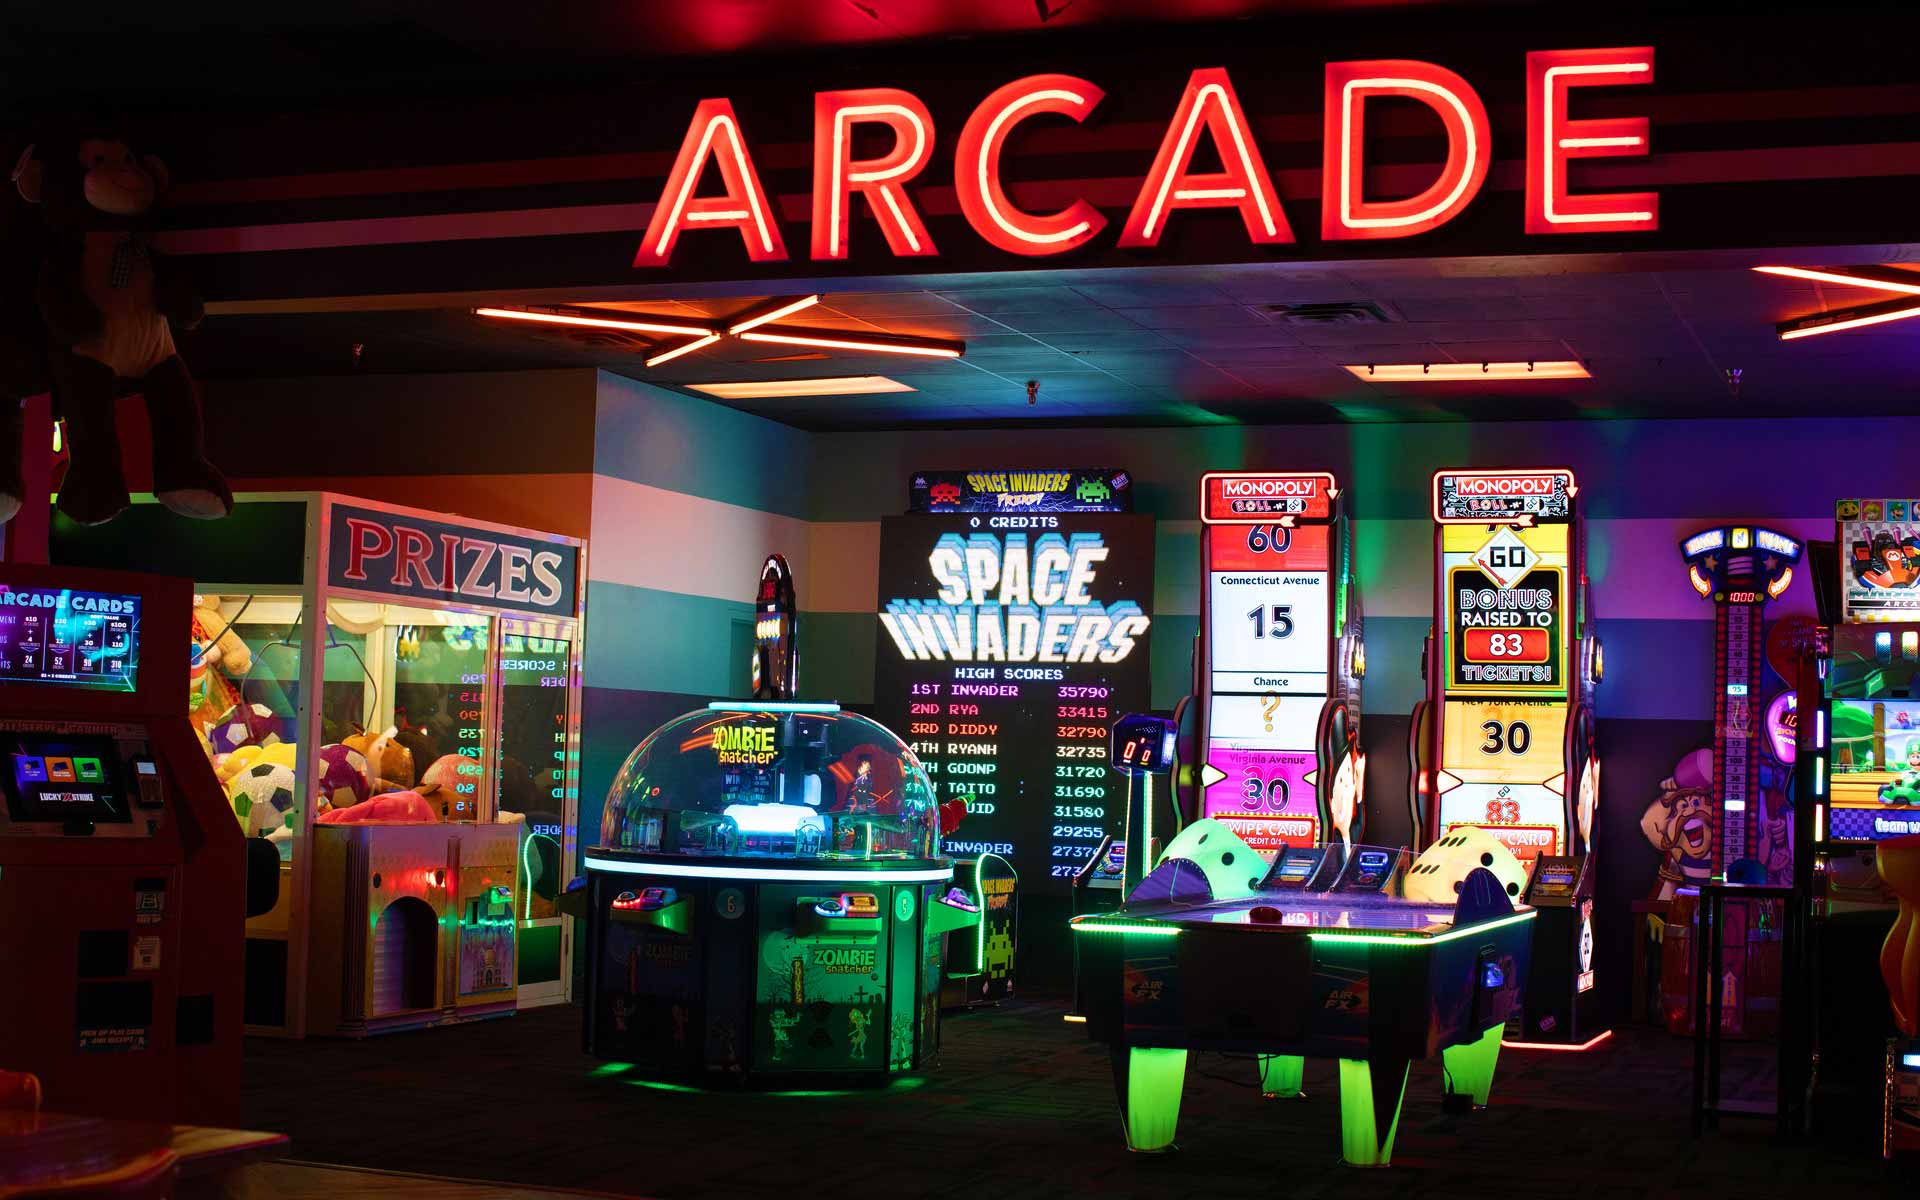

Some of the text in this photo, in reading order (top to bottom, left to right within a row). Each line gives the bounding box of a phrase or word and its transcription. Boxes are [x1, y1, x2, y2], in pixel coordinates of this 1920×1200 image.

[632, 46, 1659, 268] ARCADE
[967, 473, 1072, 492] SPACE INVADERS
[1226, 480, 1313, 495] MONOPOLY
[1460, 479, 1551, 494] MONOPOLY
[1235, 500, 1272, 511] ROLL
[1470, 500, 1508, 510] ROLL
[970, 517, 1058, 528] 0 CREDITS
[1247, 524, 1292, 554] 60
[344, 518, 562, 606] PRIZES
[1490, 546, 1525, 568] GO
[929, 534, 1109, 606] SPACE
[1220, 576, 1319, 585] Connecticut Avenue
[1460, 588, 1552, 610] BONUS
[1730, 592, 1754, 602] 1000
[72, 597, 134, 613] CARDS
[1247, 604, 1295, 639] 15
[1461, 612, 1552, 626] RAISED TO
[878, 602, 1150, 663] INVADERS
[1490, 633, 1523, 656] 83
[955, 668, 1063, 680] HIGH SCORES
[1462, 665, 1552, 681] TICKETS!
[1253, 677, 1289, 686] Chance
[911, 684, 1108, 698] 1ST INVADER 35790
[911, 703, 1108, 718] 2ND RYA 33415
[911, 723, 1107, 738] 3RD DIDDY 32790
[1480, 720, 1532, 755] 30
[719, 750, 774, 765] snatcher
[910, 742, 1106, 758] 4TH RYANH 32735
[1229, 754, 1306, 765] Virginia Avenue
[948, 763, 996, 775] GOONP
[1055, 766, 1105, 778] 31720
[39, 792, 62, 801] LUCKY
[948, 783, 996, 795] TAITO
[1054, 786, 1105, 798] 31690
[1241, 772, 1290, 812] 30
[1054, 806, 1104, 818] 31580
[1486, 800, 1520, 823] 83
[1053, 826, 1103, 838] 29255
[1268, 822, 1309, 836] CARD
[1244, 837, 1269, 845] CREDIT
[1507, 831, 1550, 846] CARD
[946, 842, 1013, 854] INVADER
[1052, 865, 1082, 877] 273
[826, 965, 874, 974] snatcher
